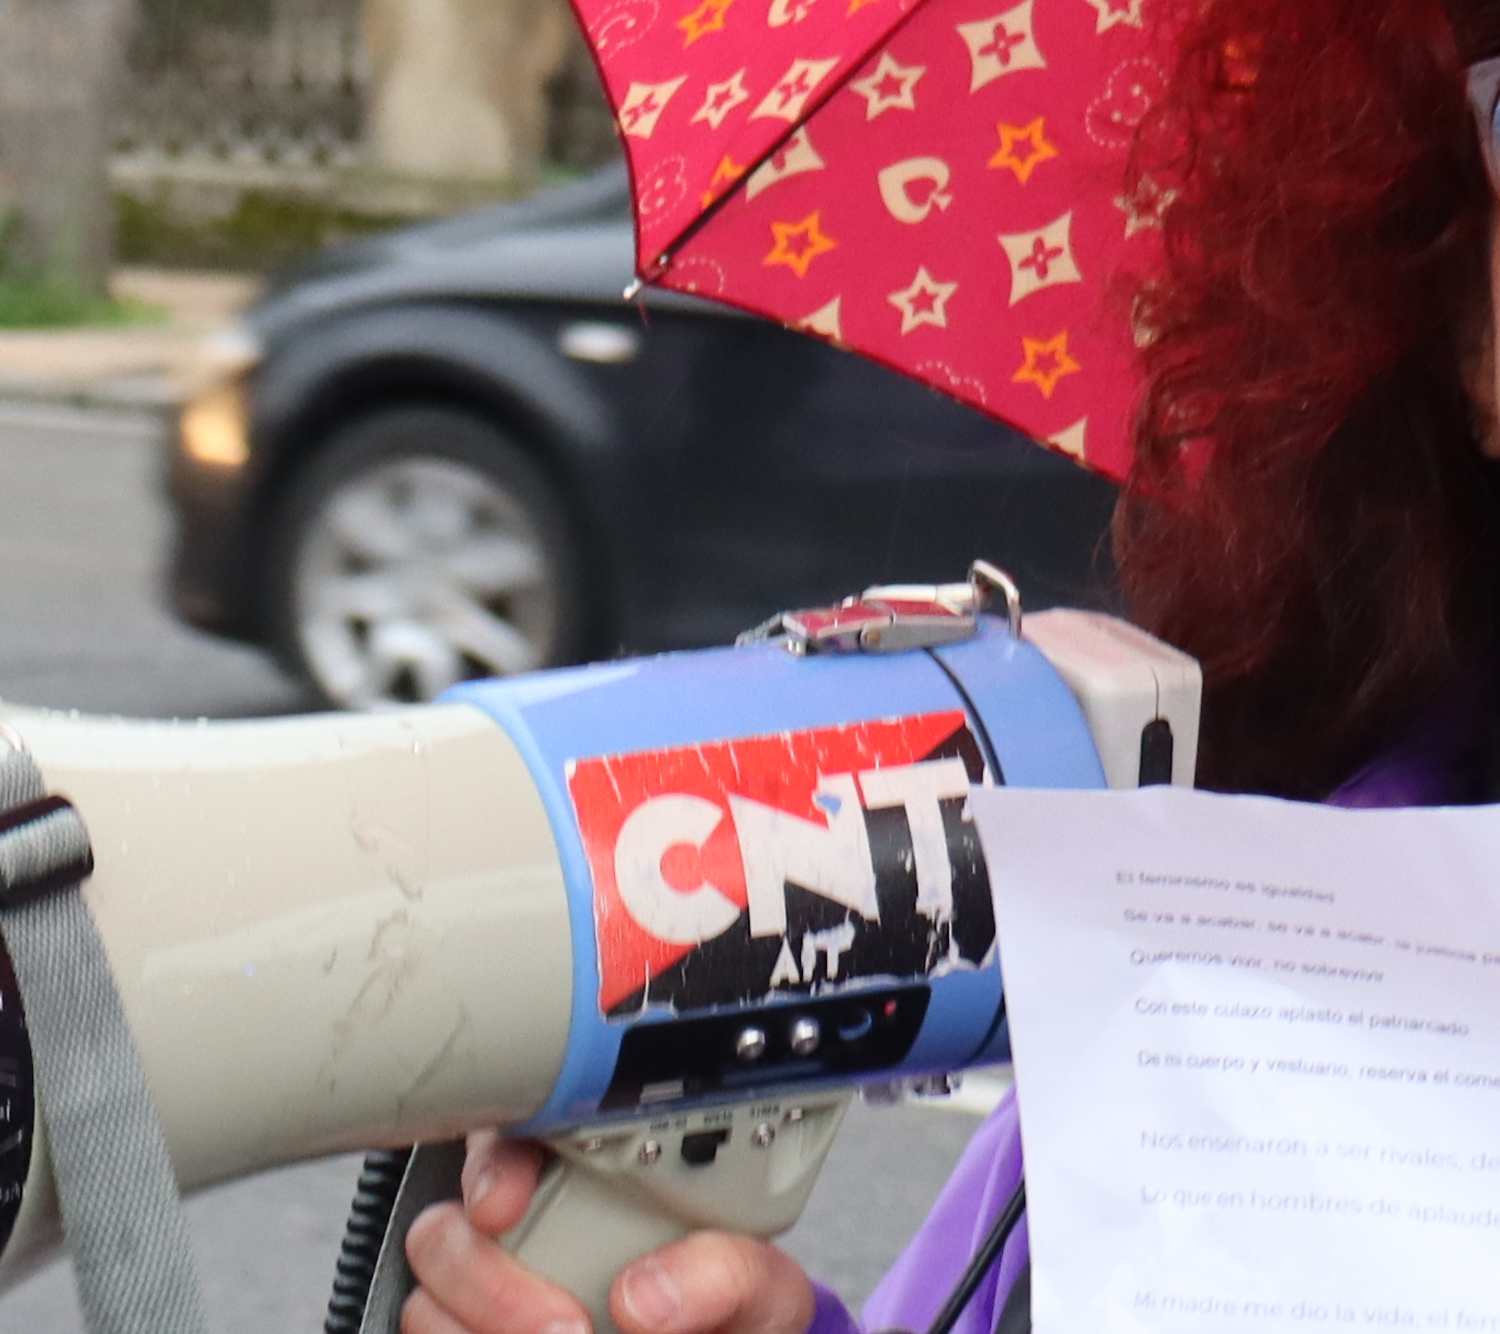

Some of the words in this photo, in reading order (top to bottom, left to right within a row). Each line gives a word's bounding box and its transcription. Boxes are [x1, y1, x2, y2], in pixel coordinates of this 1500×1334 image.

[614, 755, 971, 946] CNT
[1116, 870, 1134, 885] El
[1139, 871, 1230, 890] feminismo
[768, 921, 856, 987] AIT
[1129, 948, 1223, 966] Queremos
[1273, 959, 1296, 973] no
[1134, 997, 1167, 1016] Con
[1171, 1001, 1209, 1017] este
[1278, 1004, 1344, 1024] aplasto
[1347, 1010, 1363, 1025] el
[1368, 1014, 1471, 1037] patriarcado
[1137, 1049, 1161, 1067] De
[1164, 1051, 1183, 1067] mi
[1186, 1052, 1245, 1073] cuerpo
[1249, 1056, 1262, 1075] y
[1359, 1064, 1428, 1084] reserva
[1433, 1068, 1450, 1084] el
[1140, 1128, 1184, 1152] Nos
[1315, 1140, 1330, 1158] a
[1335, 1141, 1373, 1161] ser
[1379, 1147, 1465, 1173] rivales,
[1140, 1183, 1168, 1206] Lo
[1172, 1188, 1212, 1211] que
[1216, 1188, 1245, 1210] en
[1250, 1187, 1363, 1216] hombres
[1133, 1290, 1156, 1310] Mi
[1161, 1291, 1237, 1317] madre
[1243, 1299, 1284, 1319] me
[1290, 1298, 1330, 1322] dio
[1335, 1301, 1356, 1324] la
[1427, 1308, 1449, 1330] el
